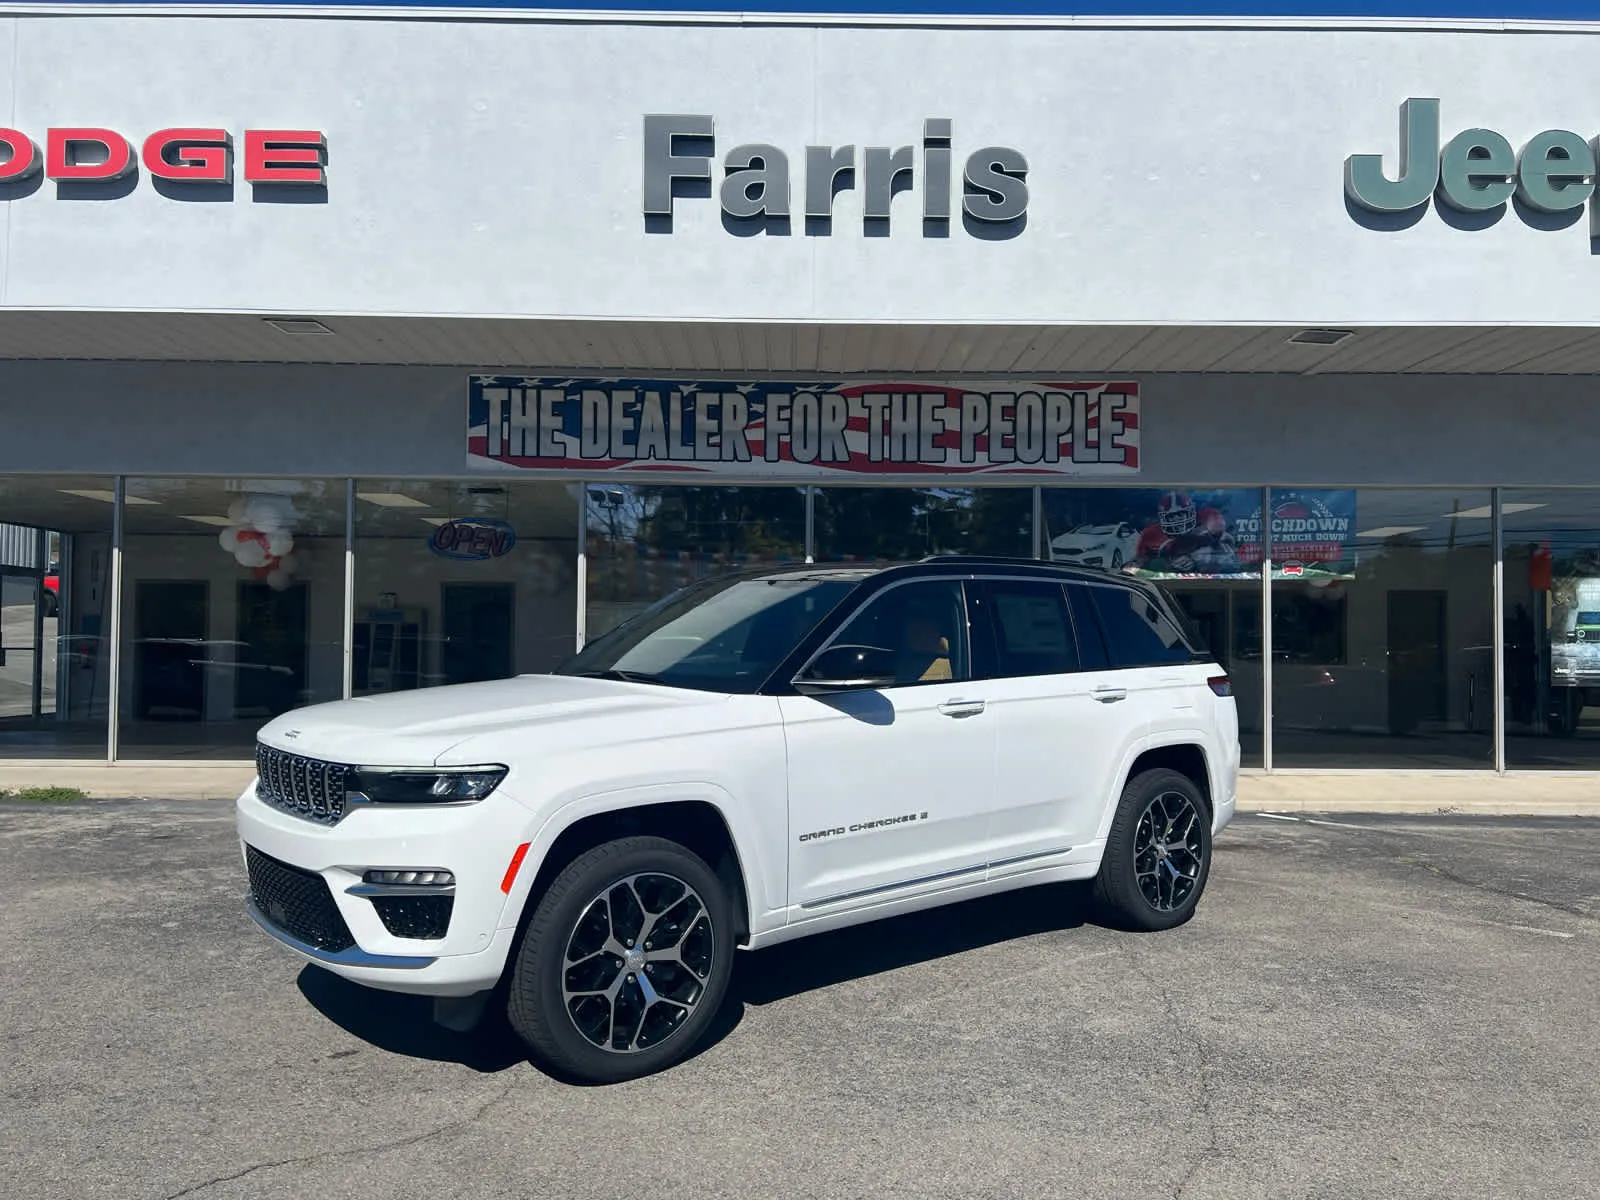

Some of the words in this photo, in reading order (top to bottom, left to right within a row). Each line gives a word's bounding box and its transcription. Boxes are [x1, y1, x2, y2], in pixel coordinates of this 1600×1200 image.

[642, 113, 1029, 222] Farris
[1344, 97, 1600, 240] Jee
[482, 386, 568, 459] THE
[580, 388, 752, 462] DEALER
[763, 391, 850, 464] FOR
[862, 392, 949, 463] THE
[960, 391, 1128, 464] PEOPLE
[435, 521, 506, 557] OPEN
[1236, 518, 1349, 532] TOCHDOWN
[799, 827, 846, 841] GRAND
[849, 814, 917, 831] CHEROKEE
